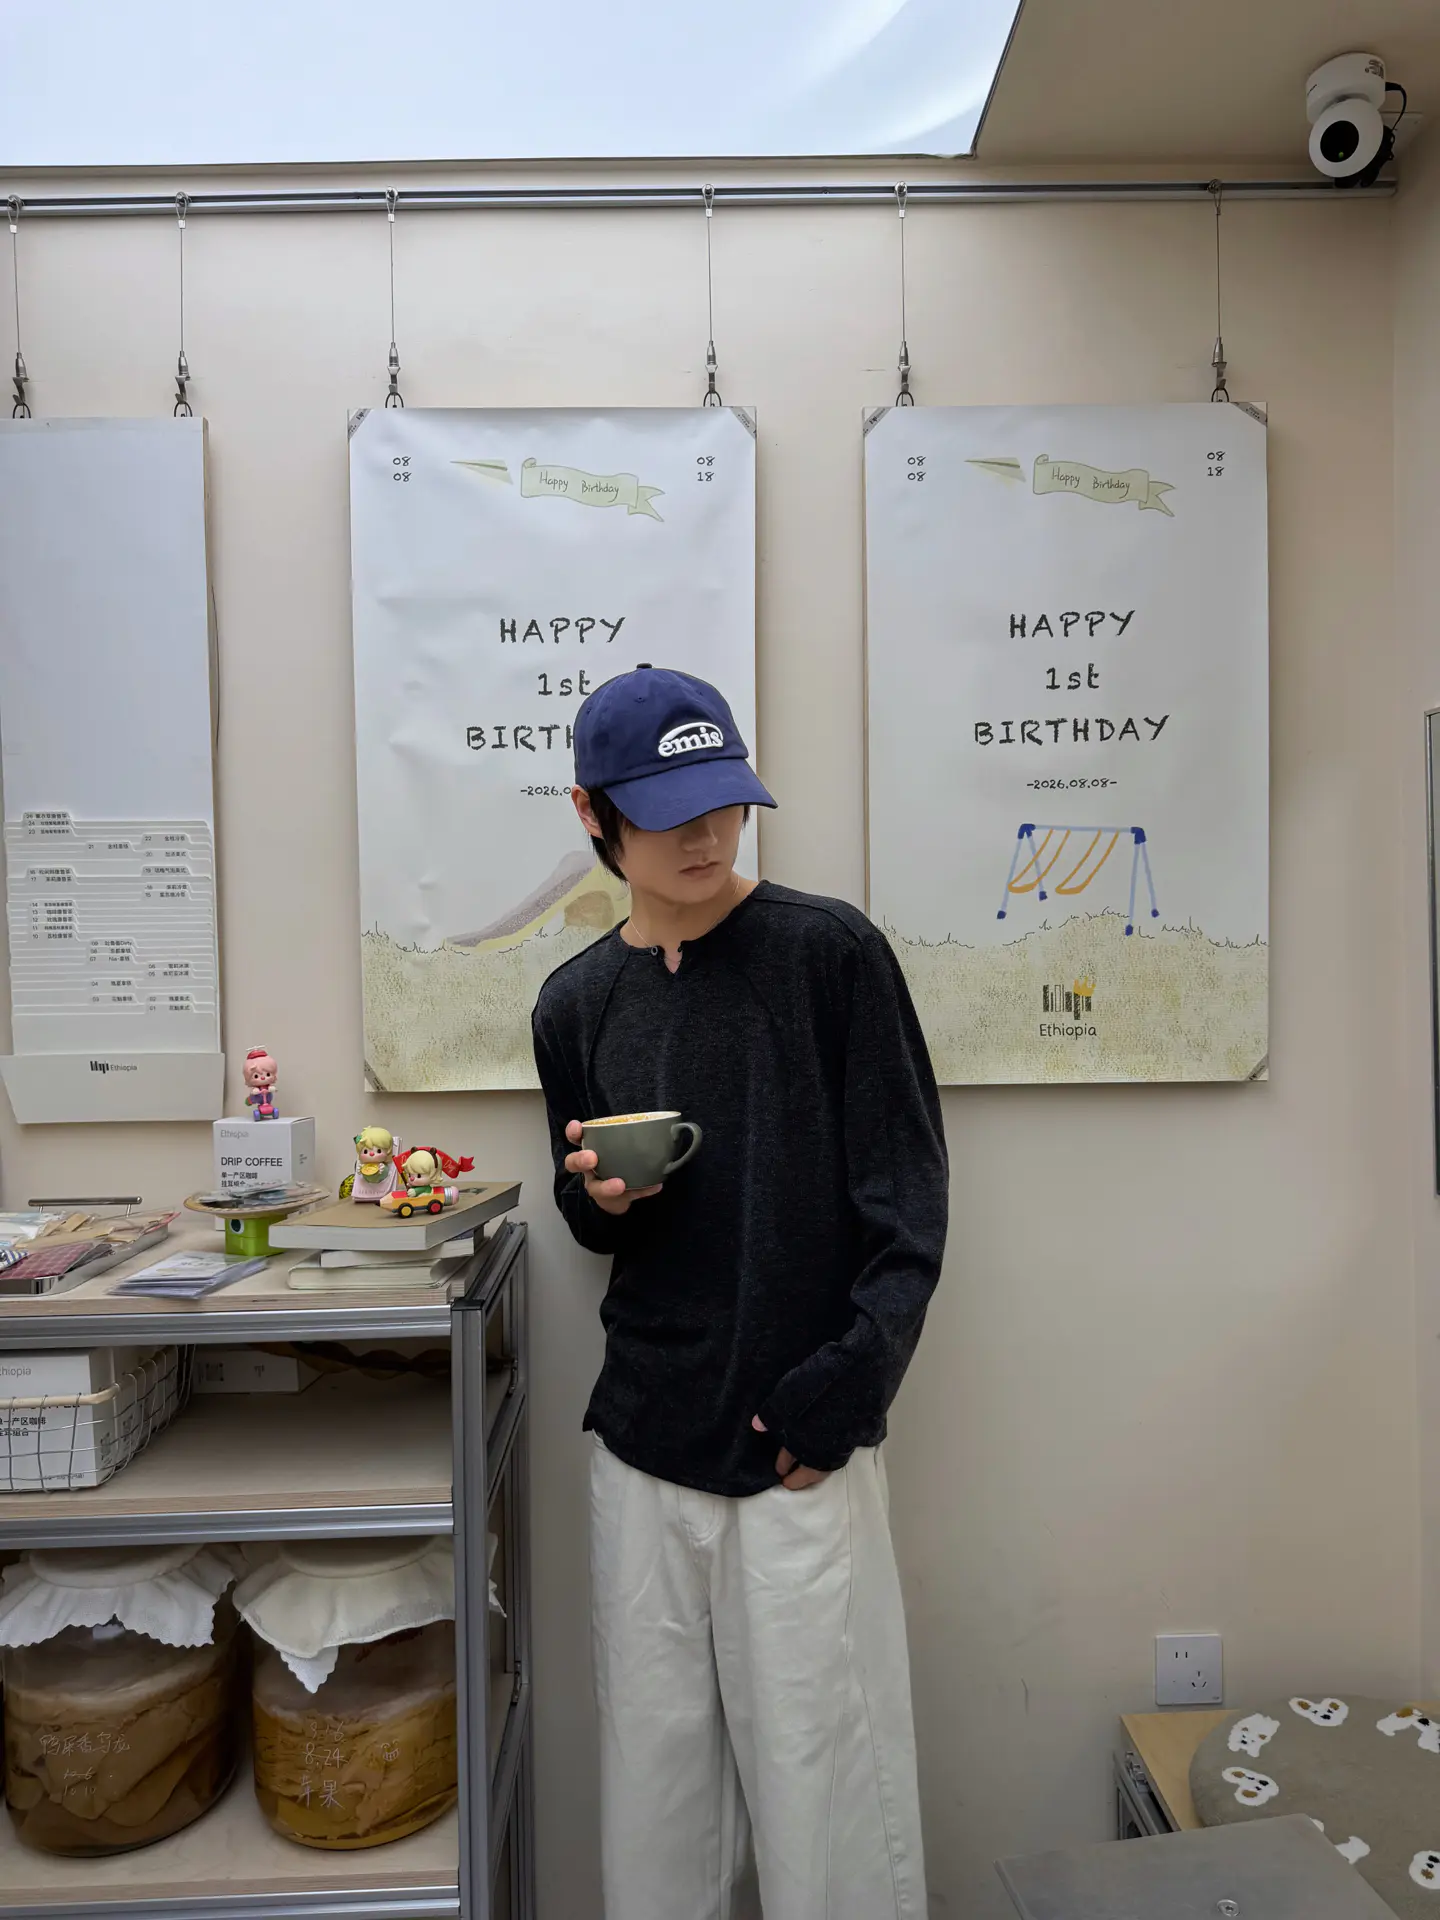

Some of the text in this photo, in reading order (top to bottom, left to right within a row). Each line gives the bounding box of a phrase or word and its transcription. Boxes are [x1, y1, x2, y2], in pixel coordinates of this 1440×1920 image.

[393, 456, 411, 466] 08
[697, 456, 715, 466] 08
[908, 456, 926, 466] 08
[1207, 451, 1225, 461] 08
[393, 472, 411, 482] 08
[697, 471, 714, 482] 18
[908, 472, 926, 482] 08
[1207, 466, 1224, 477] 18
[540, 471, 619, 503] Happy Birthday
[1051, 466, 1131, 499] Happy Birthday
[1009, 610, 1135, 638] HAPPY
[500, 616, 625, 644] HAPPY
[1046, 663, 1099, 690] 1st
[538, 669, 591, 696] 1st
[975, 715, 1170, 746] BIRTHDAY
[657, 724, 724, 758] emis
[1039, 1023, 1097, 1040] Ethiopia
[110, 1063, 138, 1072] Ethiopia
[220, 1129, 249, 1139] Ethiopia
[220, 1157, 283, 1167] DRIP COFFEE
[221, 1171, 258, 1179] 单一产区咖啡
[299, 1773, 347, 1810] 苹果
